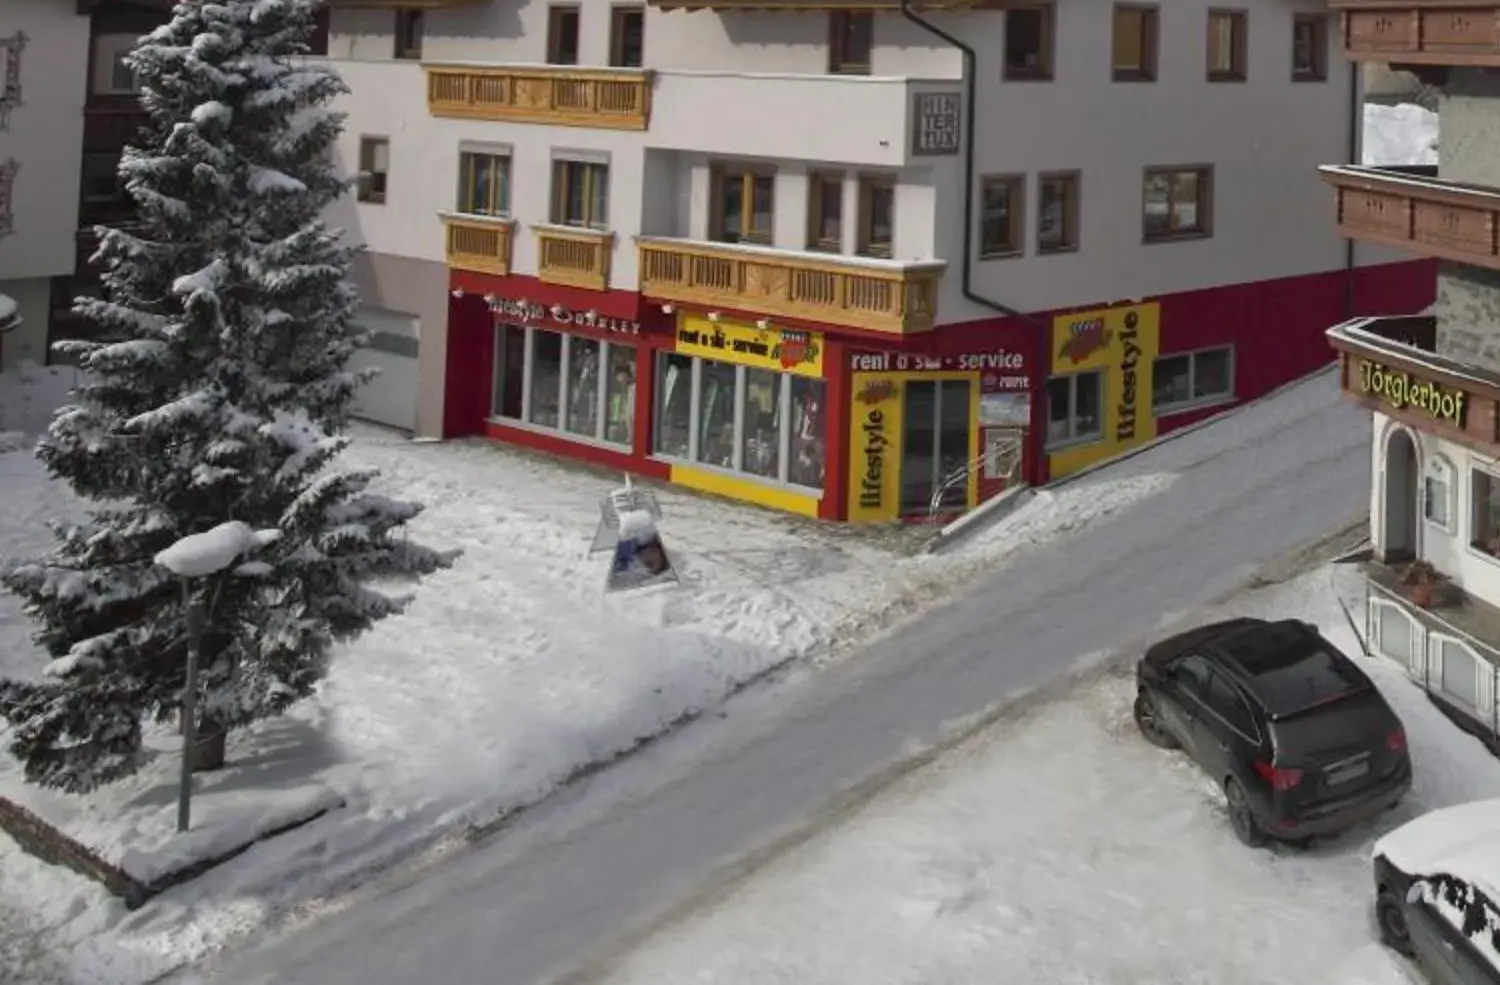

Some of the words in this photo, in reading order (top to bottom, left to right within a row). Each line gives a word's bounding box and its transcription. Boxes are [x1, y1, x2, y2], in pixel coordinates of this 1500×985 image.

[958, 348, 1024, 369] service
[1117, 311, 1142, 444] lifestyle
[1360, 360, 1464, 426] Jörglerhof
[859, 408, 888, 508] lifestyle
